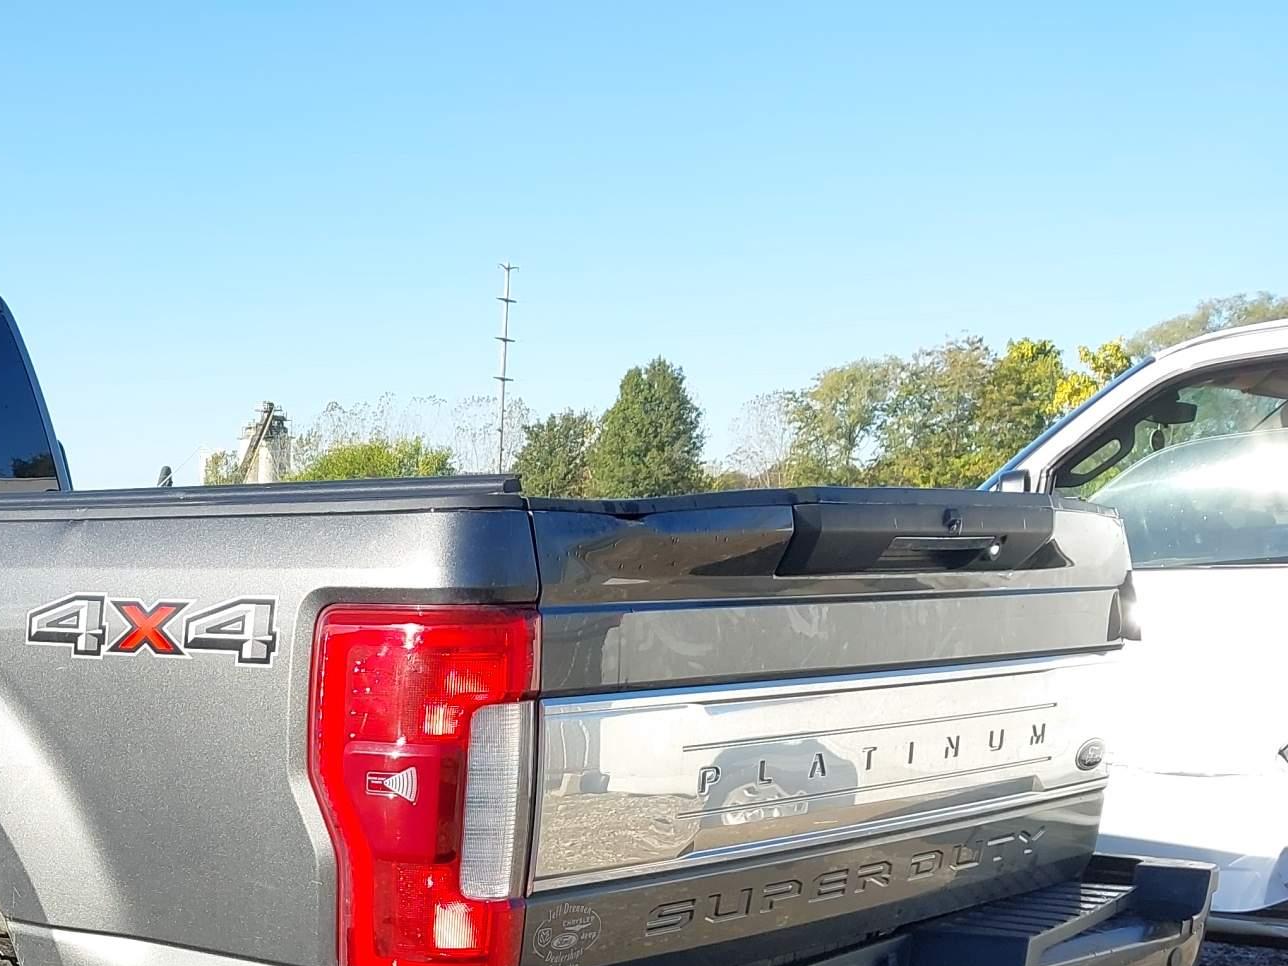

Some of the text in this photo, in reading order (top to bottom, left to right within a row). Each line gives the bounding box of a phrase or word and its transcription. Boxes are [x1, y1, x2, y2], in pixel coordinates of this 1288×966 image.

[26, 592, 279, 668] 4X4
[697, 723, 1047, 796] PLATINUM
[646, 825, 1047, 937] SUPER DUTY
